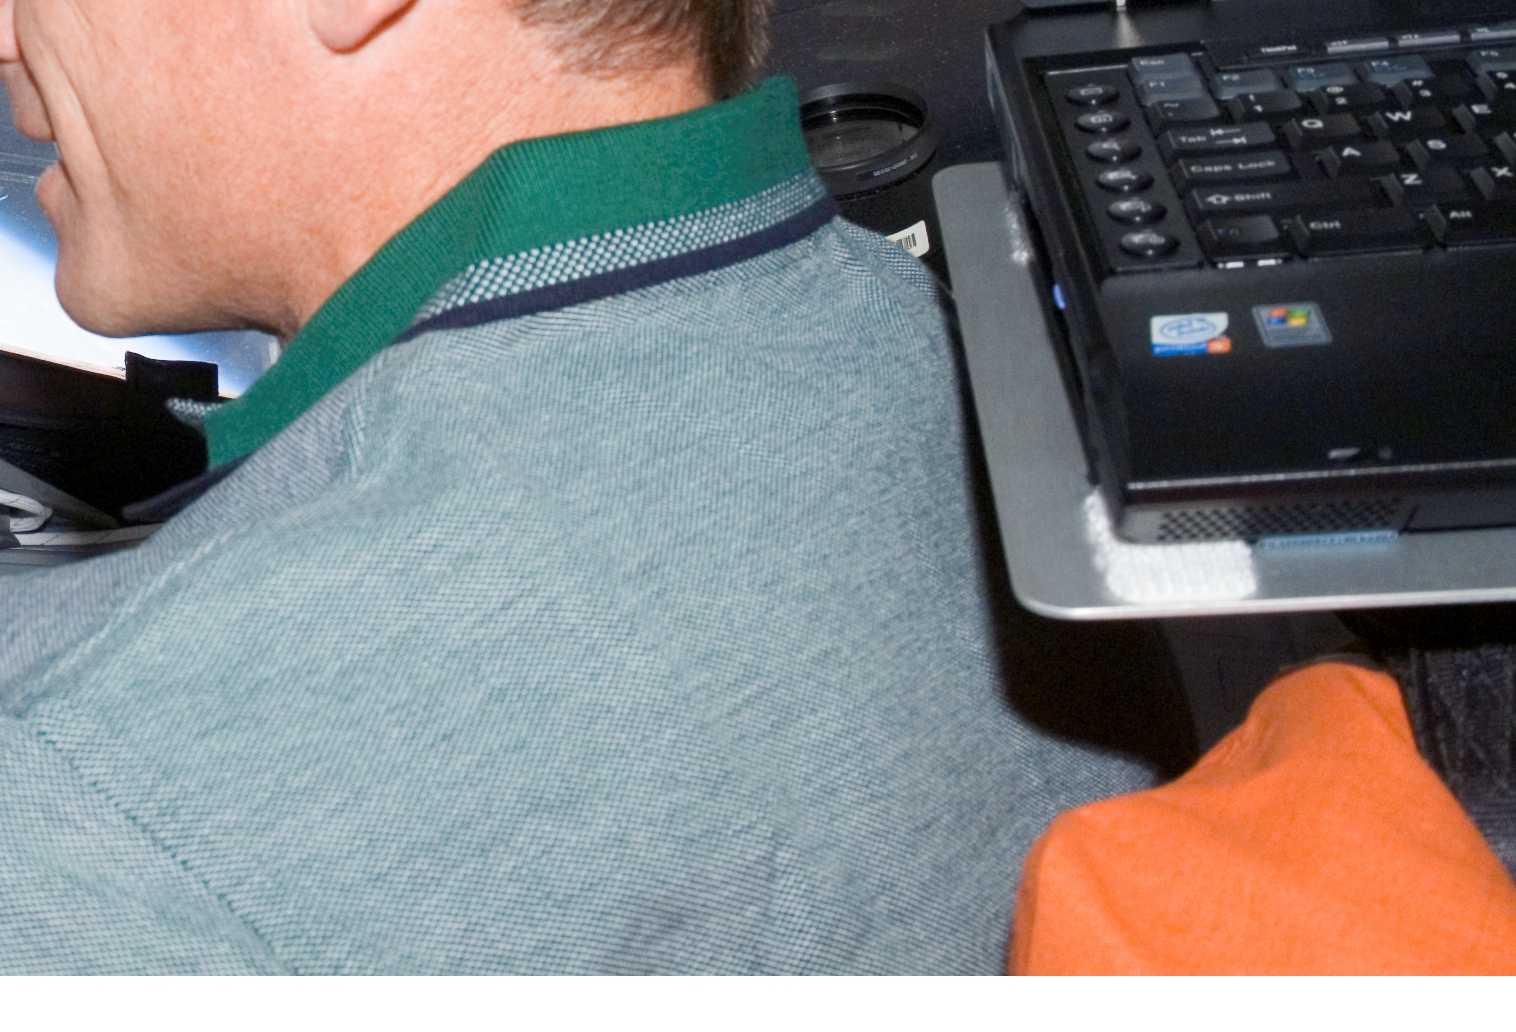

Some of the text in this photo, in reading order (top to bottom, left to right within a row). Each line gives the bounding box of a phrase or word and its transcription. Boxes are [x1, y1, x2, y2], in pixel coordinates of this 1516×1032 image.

[1179, 110, 1412, 143] Tab Q W
[1342, 146, 1362, 157] A
[1190, 160, 1276, 173] Caps Lock
[1400, 166, 1513, 185] Z X
[1233, 191, 1272, 202] Shift
[1309, 210, 1473, 230] Ctrl Alt
